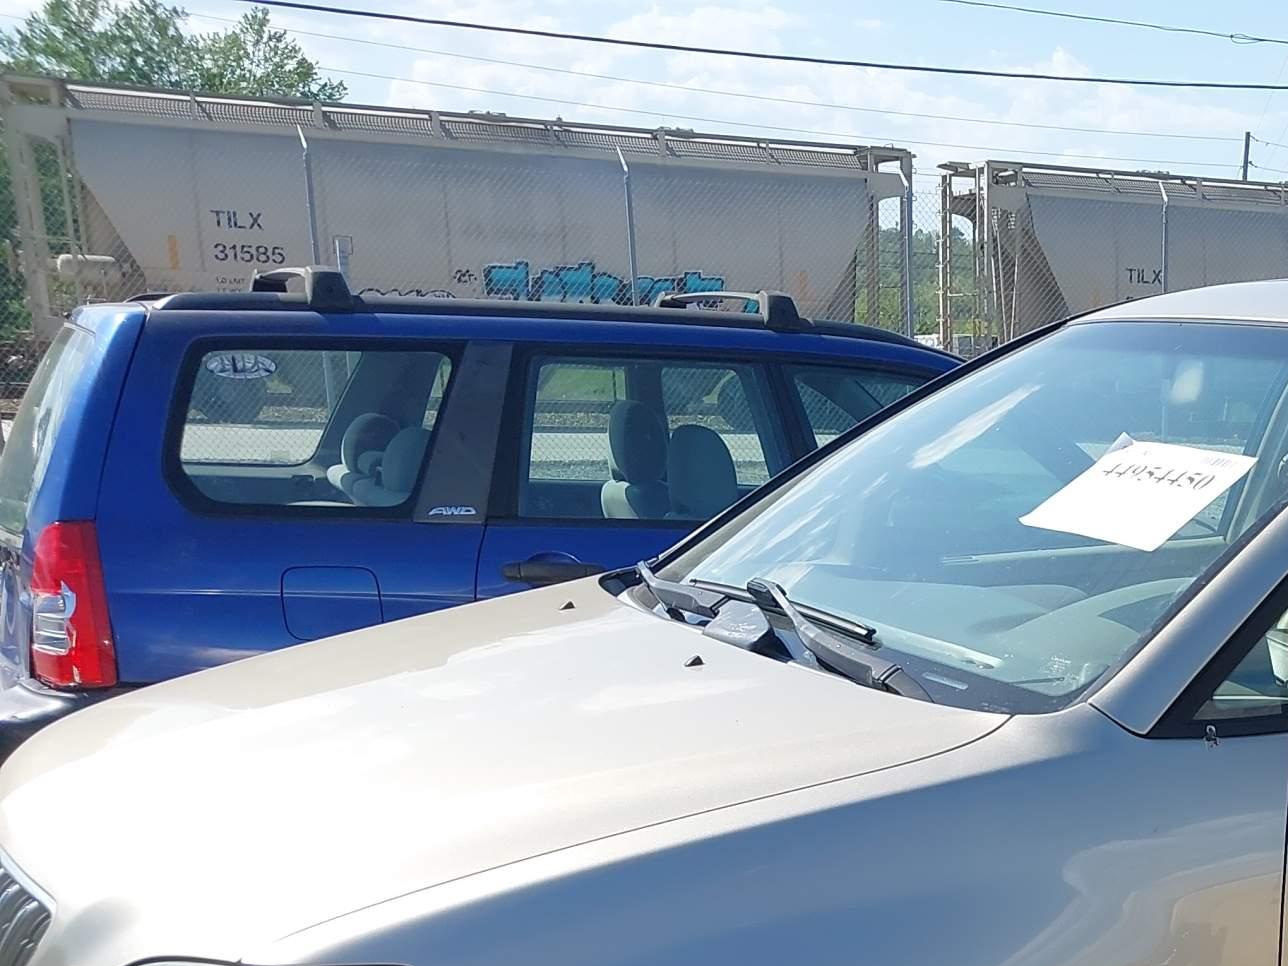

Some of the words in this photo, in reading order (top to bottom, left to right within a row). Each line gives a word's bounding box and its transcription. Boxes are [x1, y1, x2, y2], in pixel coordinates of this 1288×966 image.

[210, 209, 264, 231] TILX
[213, 242, 286, 264] 31585
[1125, 268, 1163, 285] TILX
[428, 506, 477, 516] AWD
